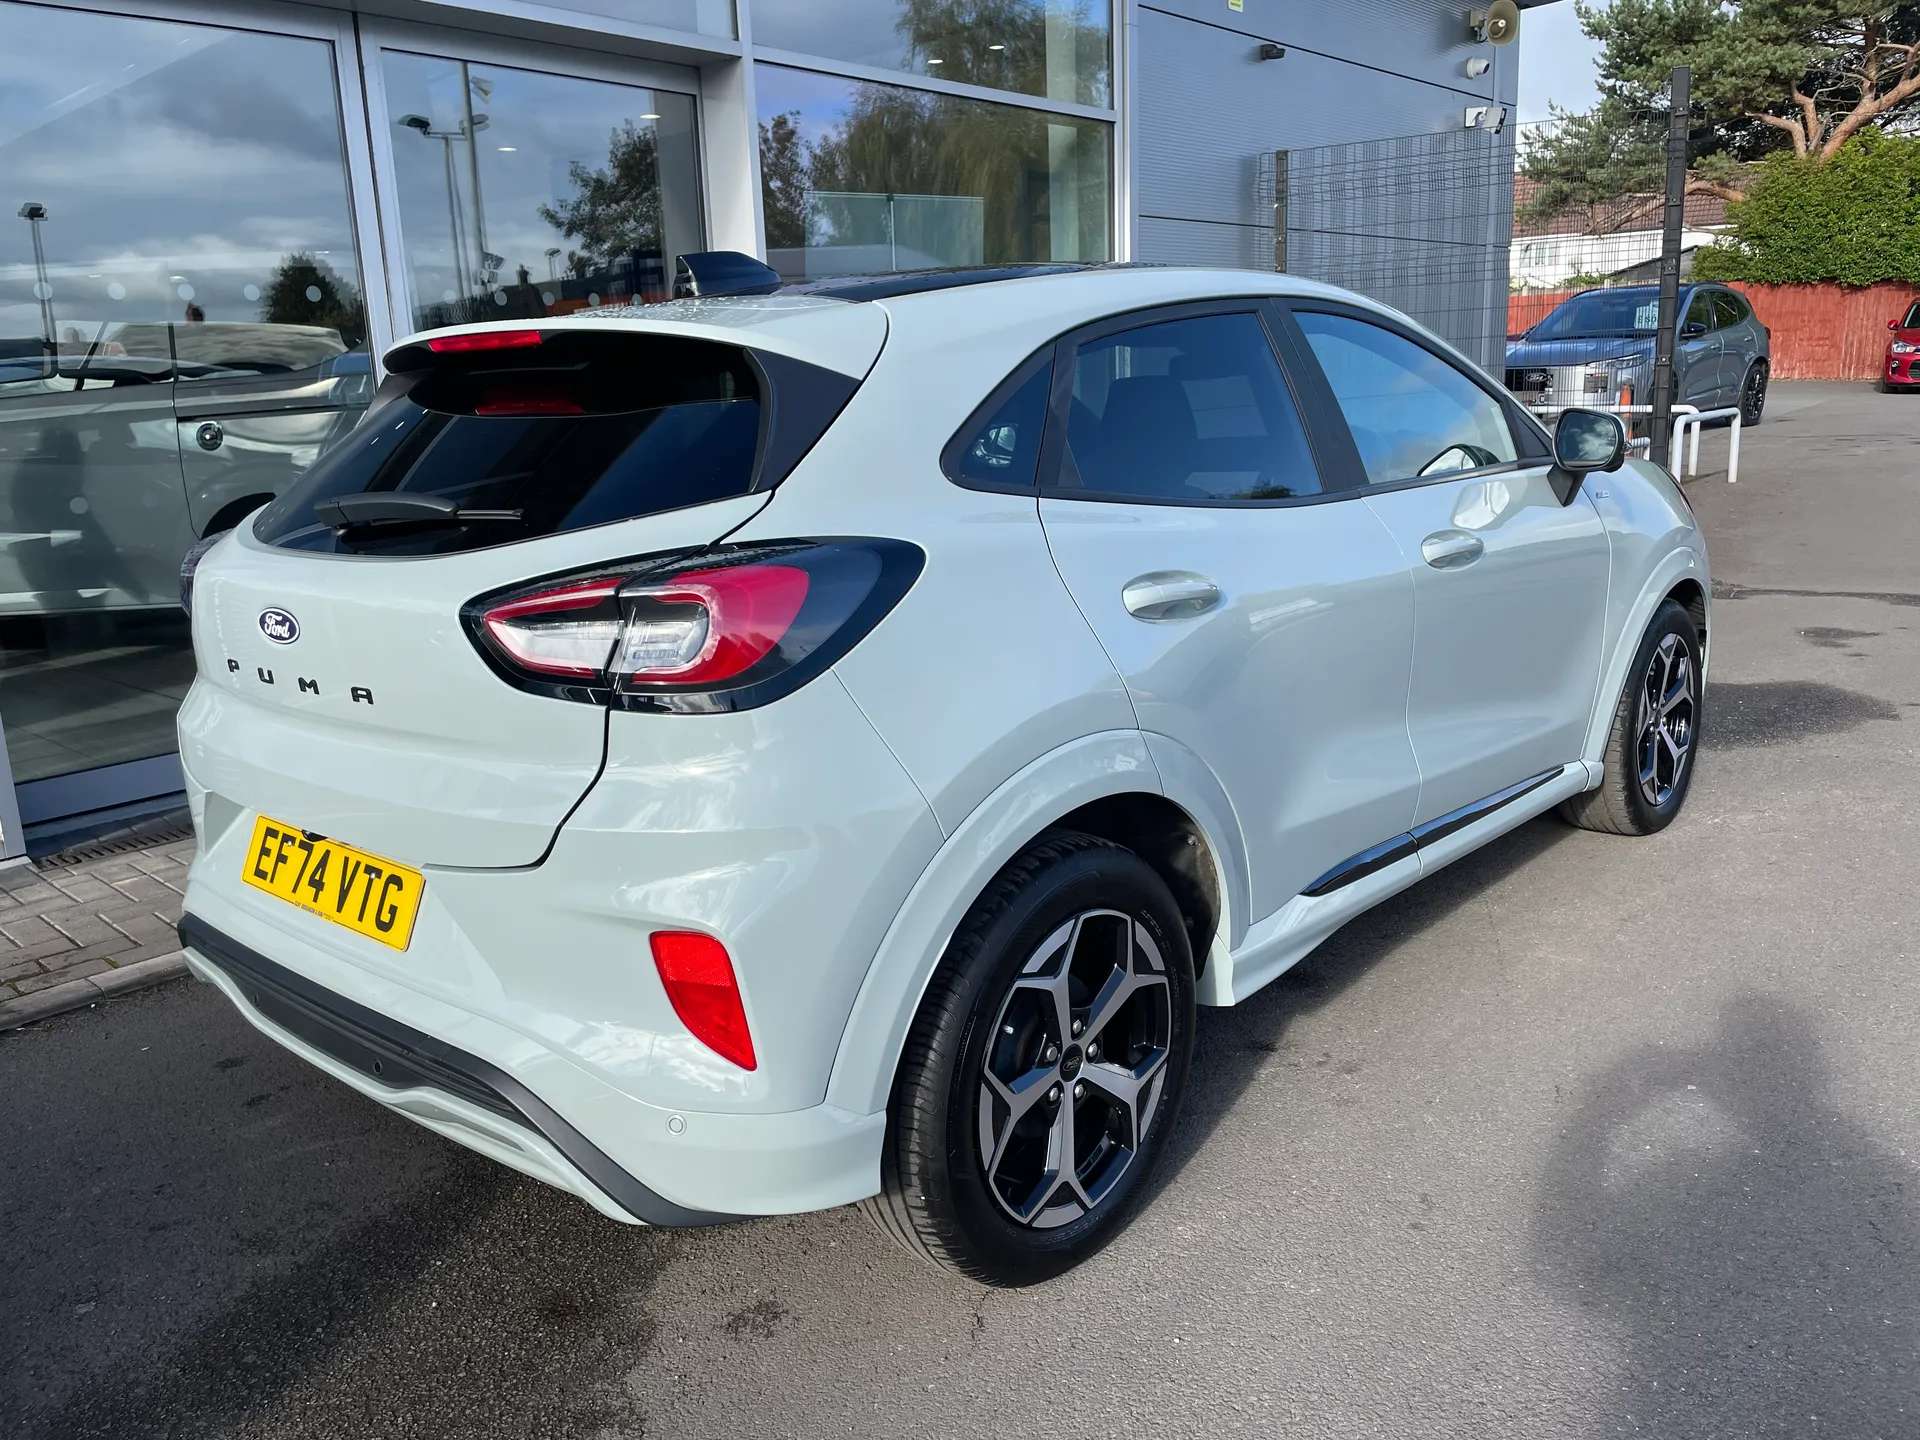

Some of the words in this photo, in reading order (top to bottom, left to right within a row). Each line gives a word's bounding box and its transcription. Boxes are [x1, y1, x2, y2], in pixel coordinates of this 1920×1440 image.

[264, 611, 291, 639] Ford
[227, 658, 374, 705] PUMA
[253, 826, 331, 903] EF74
[336, 855, 403, 933] VTG
